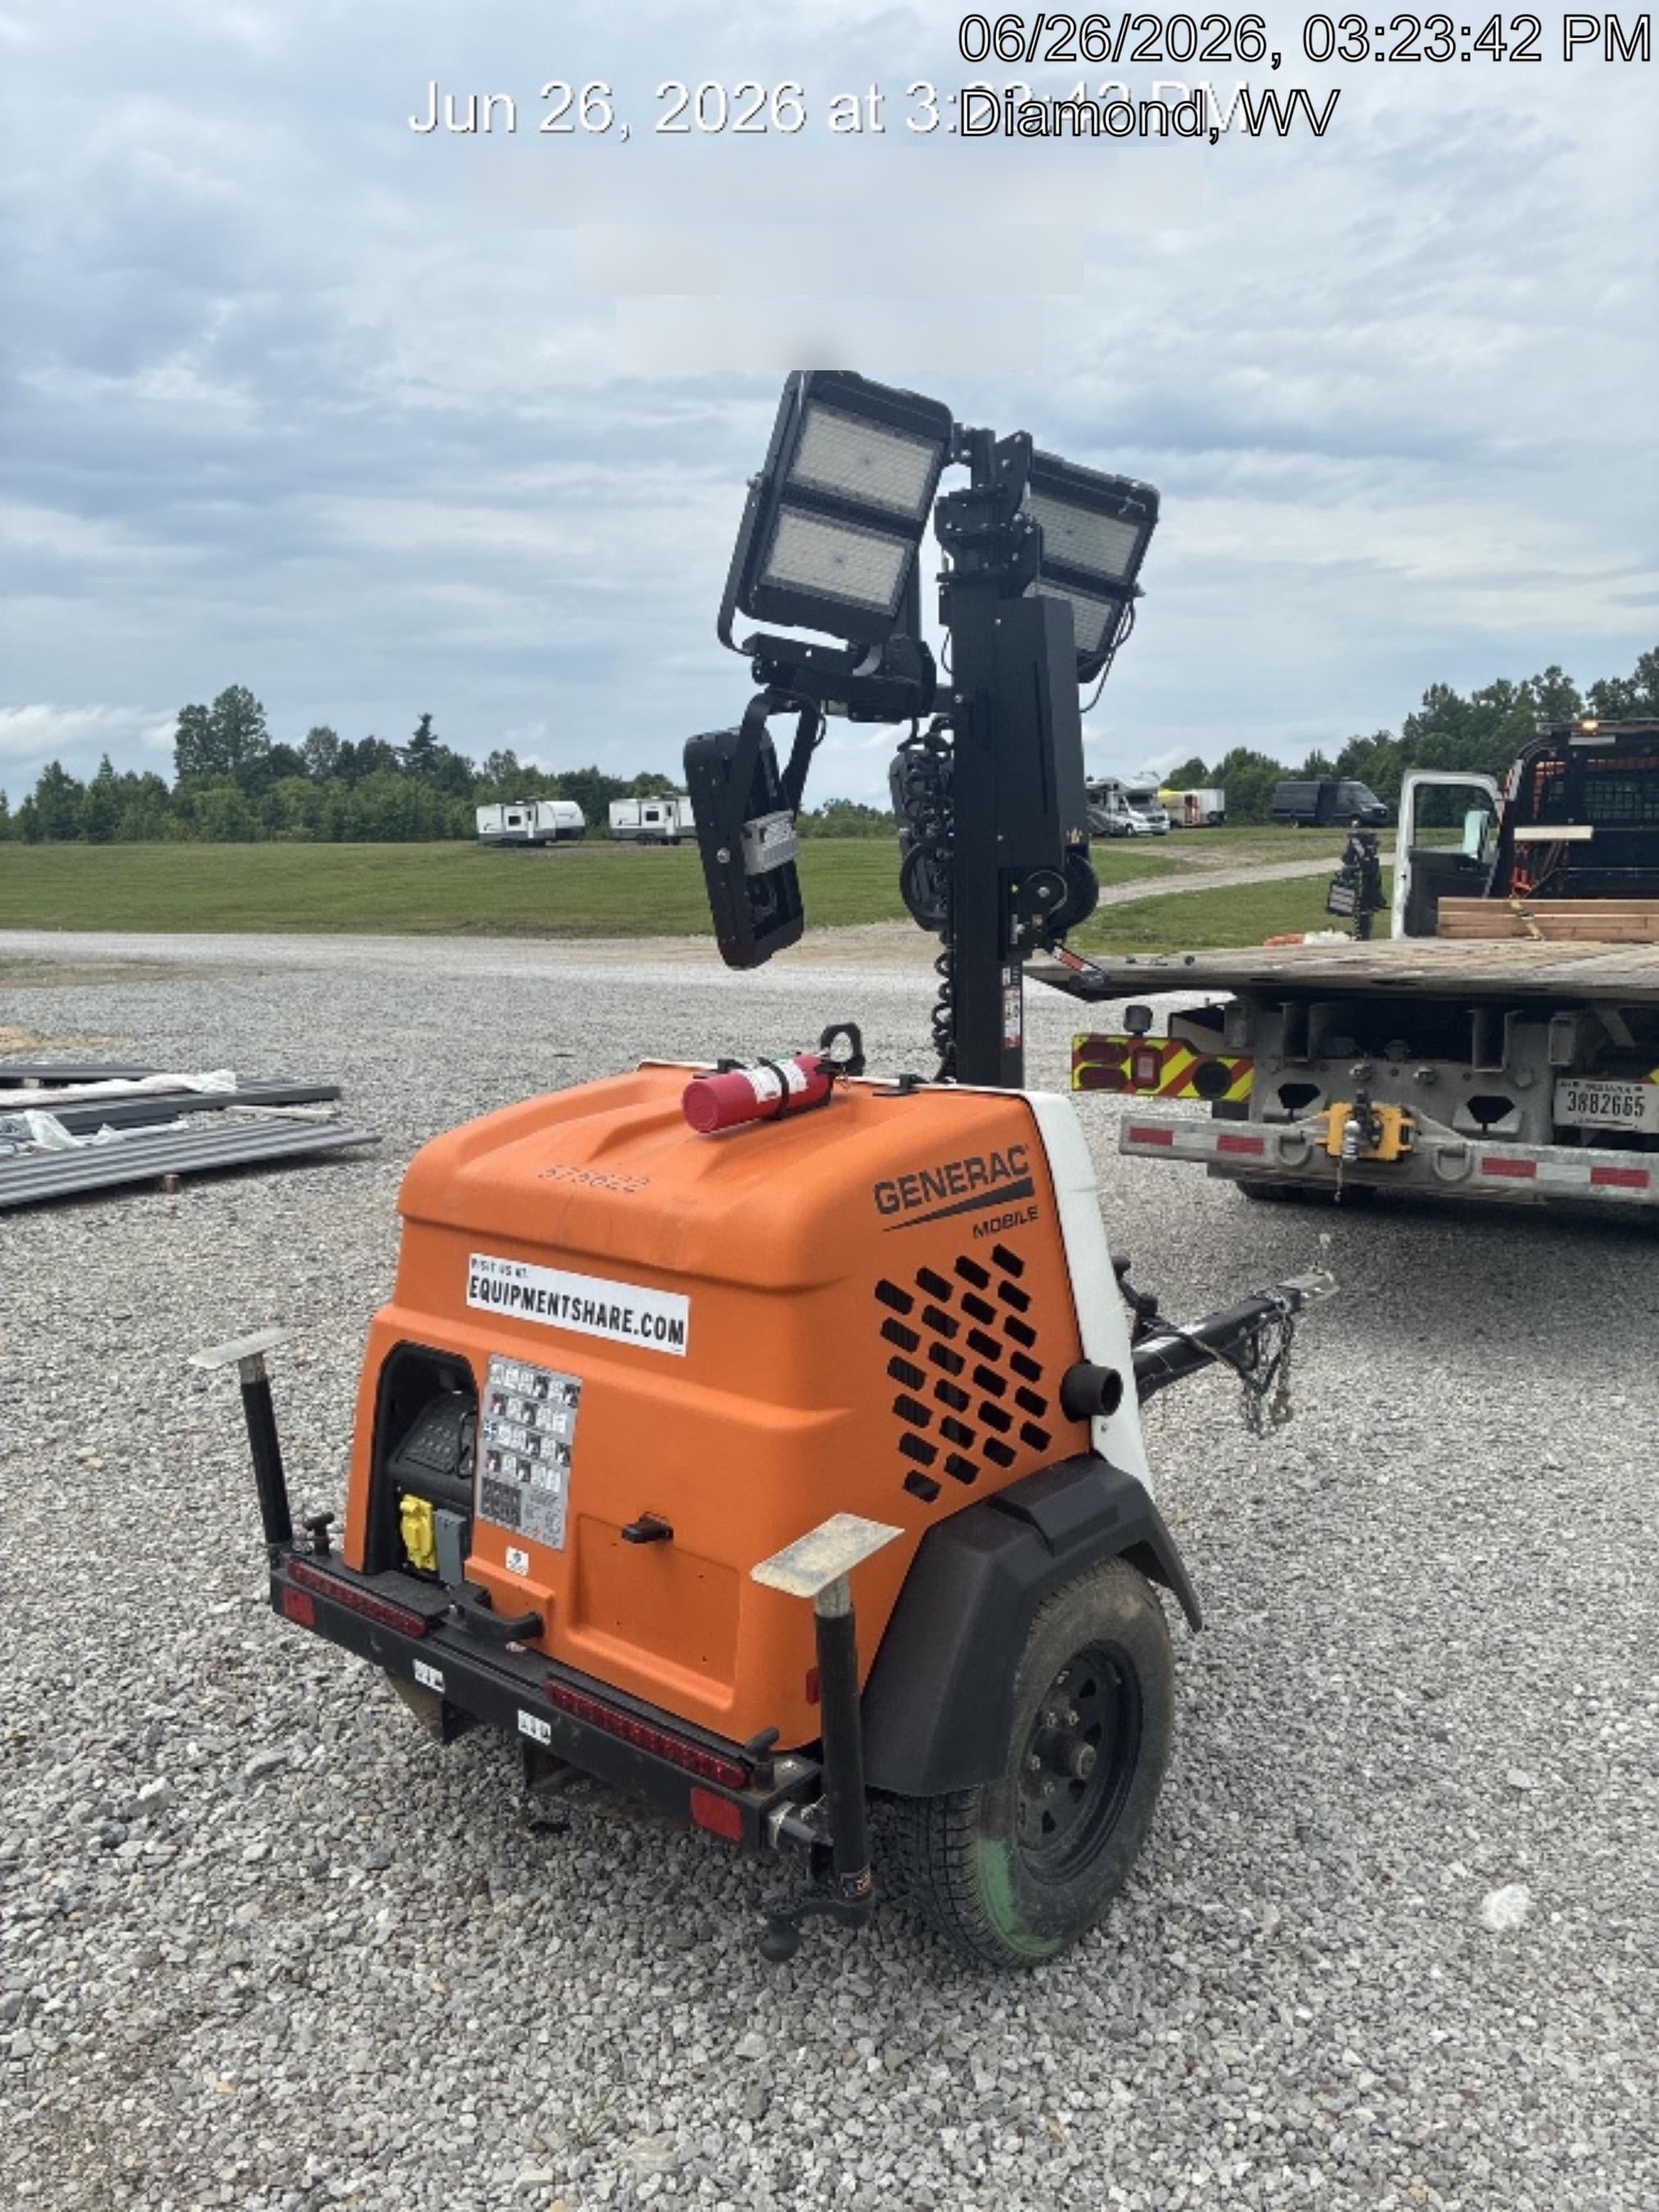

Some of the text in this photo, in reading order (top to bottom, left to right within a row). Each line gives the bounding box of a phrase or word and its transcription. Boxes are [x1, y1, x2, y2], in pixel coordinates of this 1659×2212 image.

[874, 1145, 1030, 1215] GENERAC
[972, 1204, 1039, 1239] MOBILE
[469, 1275, 684, 1345] EQUIPMENTSHARE.COM
